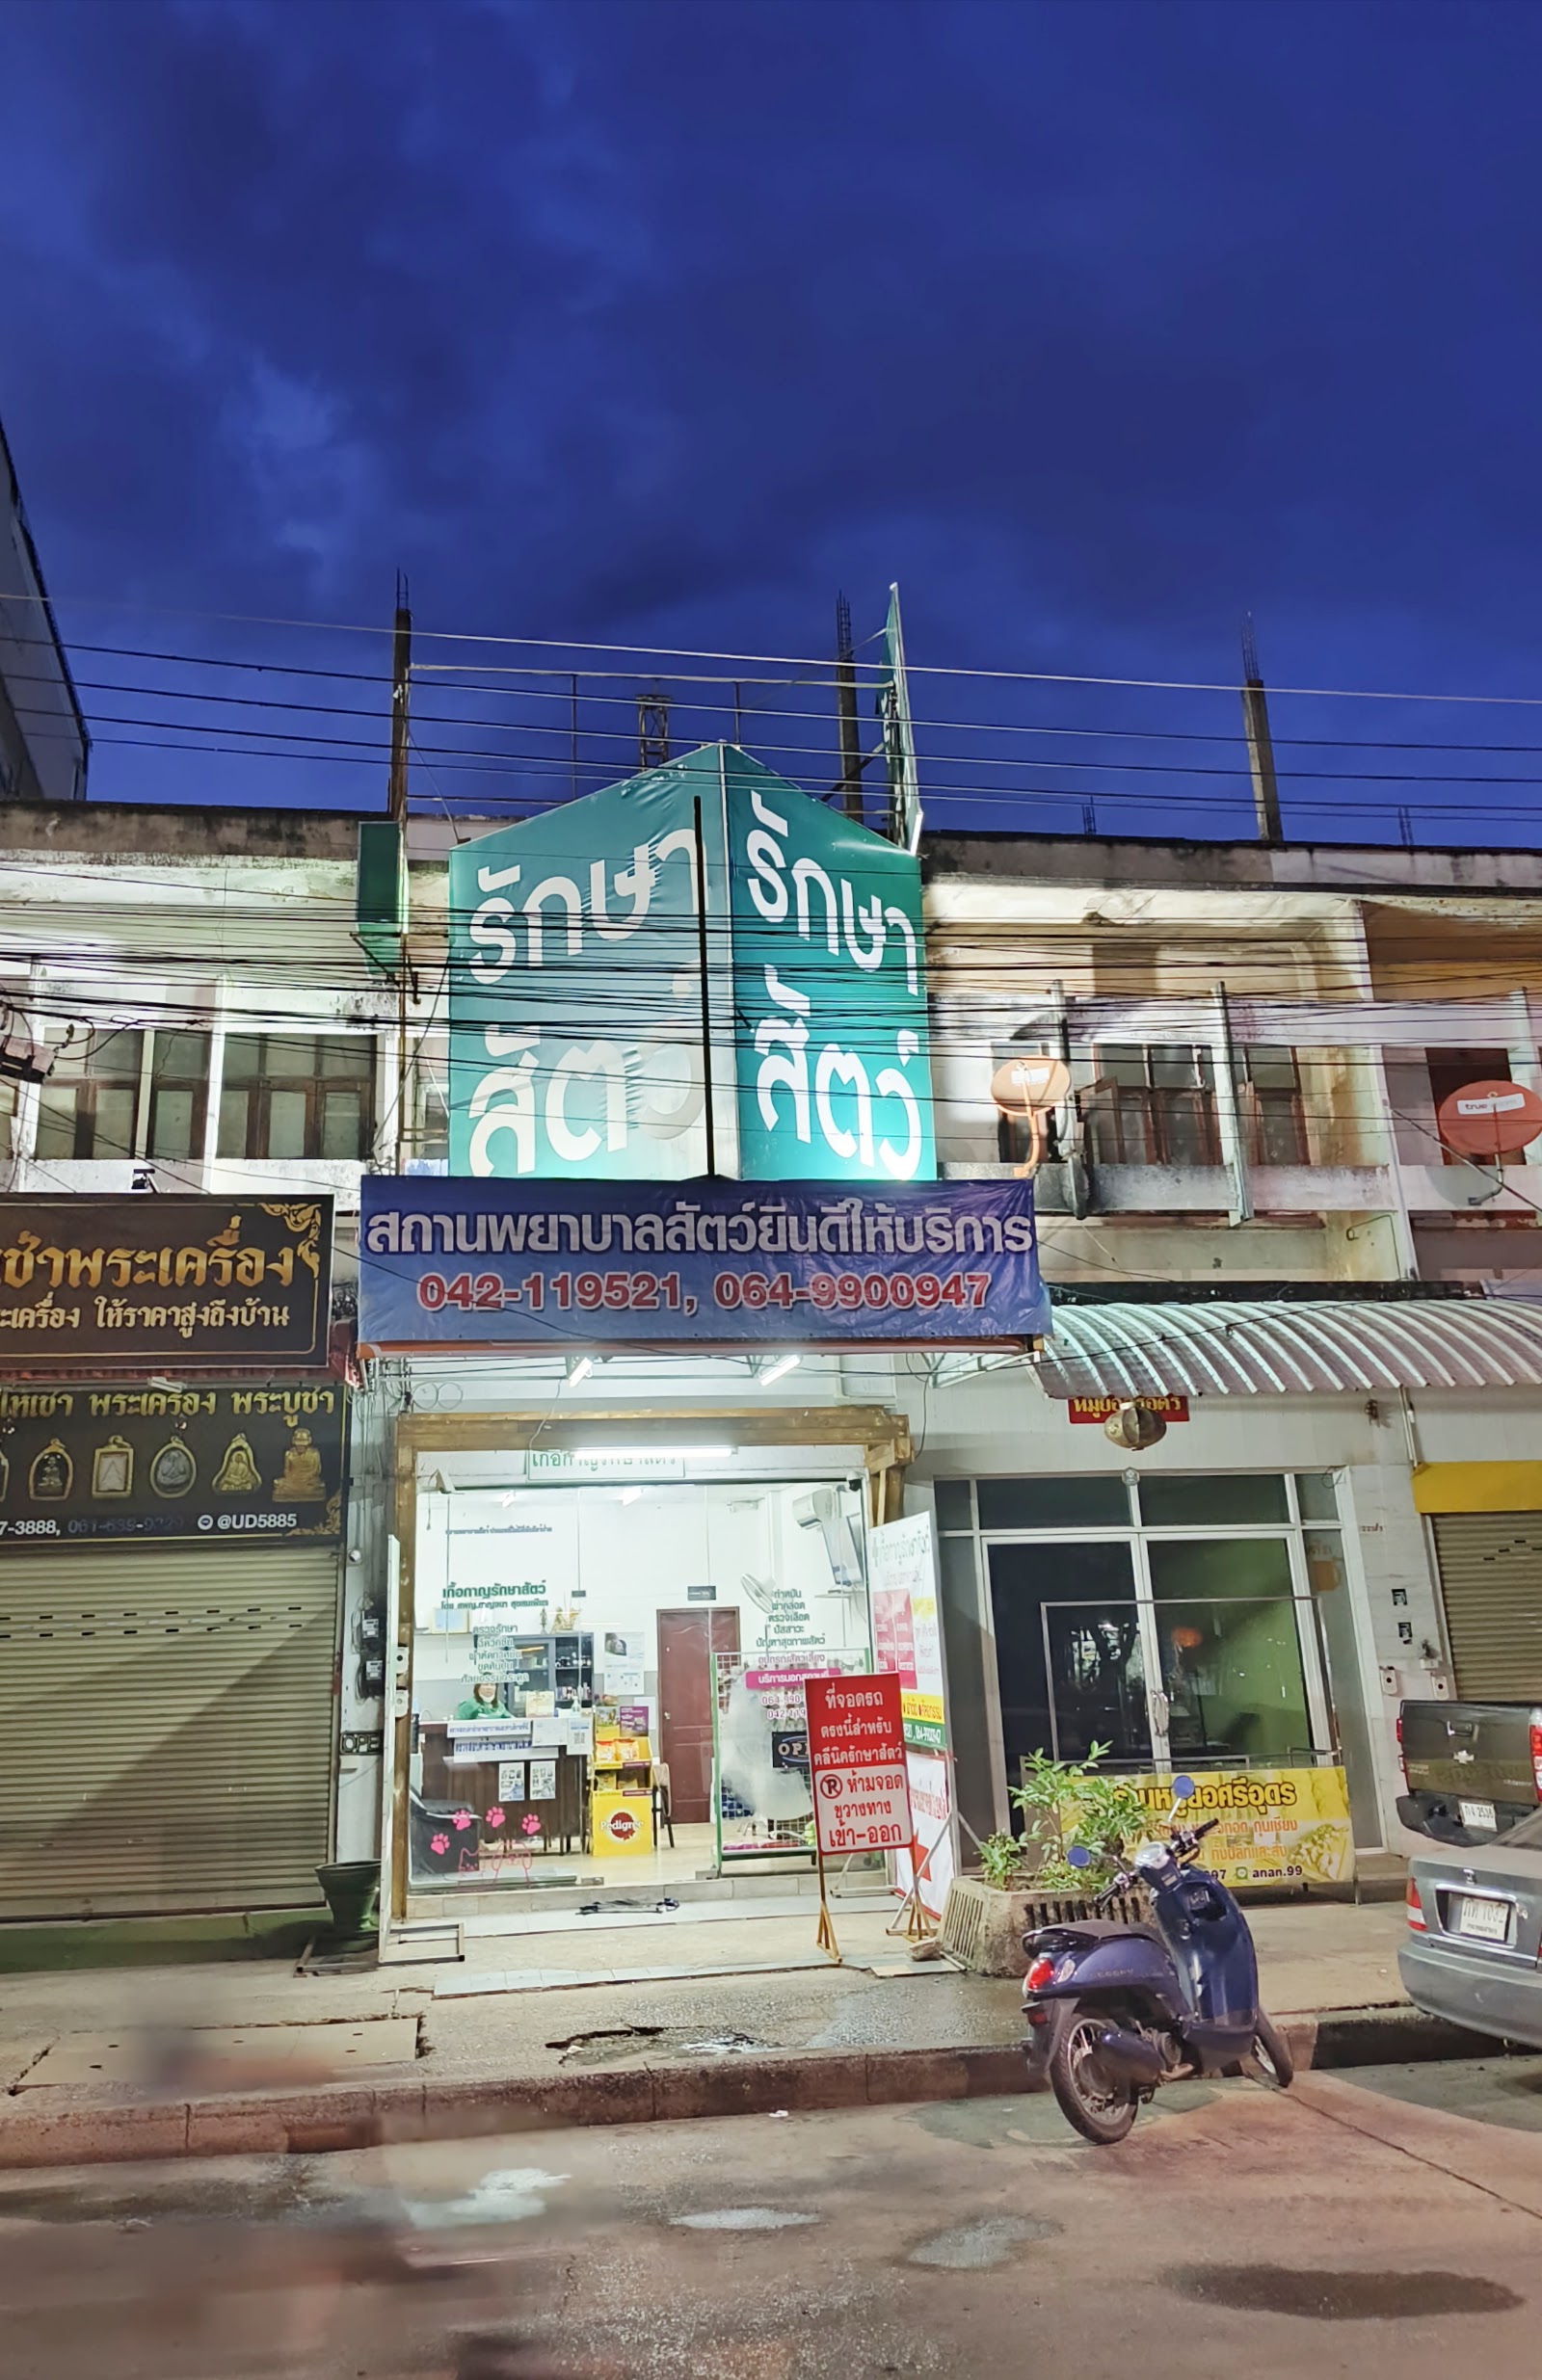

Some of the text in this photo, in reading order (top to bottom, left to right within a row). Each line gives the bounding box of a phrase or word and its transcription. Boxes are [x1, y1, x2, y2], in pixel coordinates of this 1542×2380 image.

[468, 828, 709, 985] รักษา
[747, 790, 919, 996] รักษา
[756, 965, 923, 1182] สัตว์
[366, 1198, 1034, 1254] สถานพยาบาลสัตว์ยินดีให้บริการ
[416, 1272, 992, 1317] 042-119521, 064-9900947
[93, 1295, 290, 1338] ให้ราคาสูงถึงบ้าน
[231, 1388, 334, 1427] พระบูชา
[218, 1514, 298, 1530] @UD5885
[825, 1682, 884, 1709] ที่จอดรถ
[813, 1741, 903, 1766] คลีนิครักษาสัตว์
[846, 1769, 903, 1793] ห้ามจอด
[834, 1800, 892, 1819] ขวางทาง
[599, 1819, 644, 1833] Pedigree
[829, 1819, 902, 1847] เข้า-ออก
[1252, 1865, 1303, 1878] anan.99
